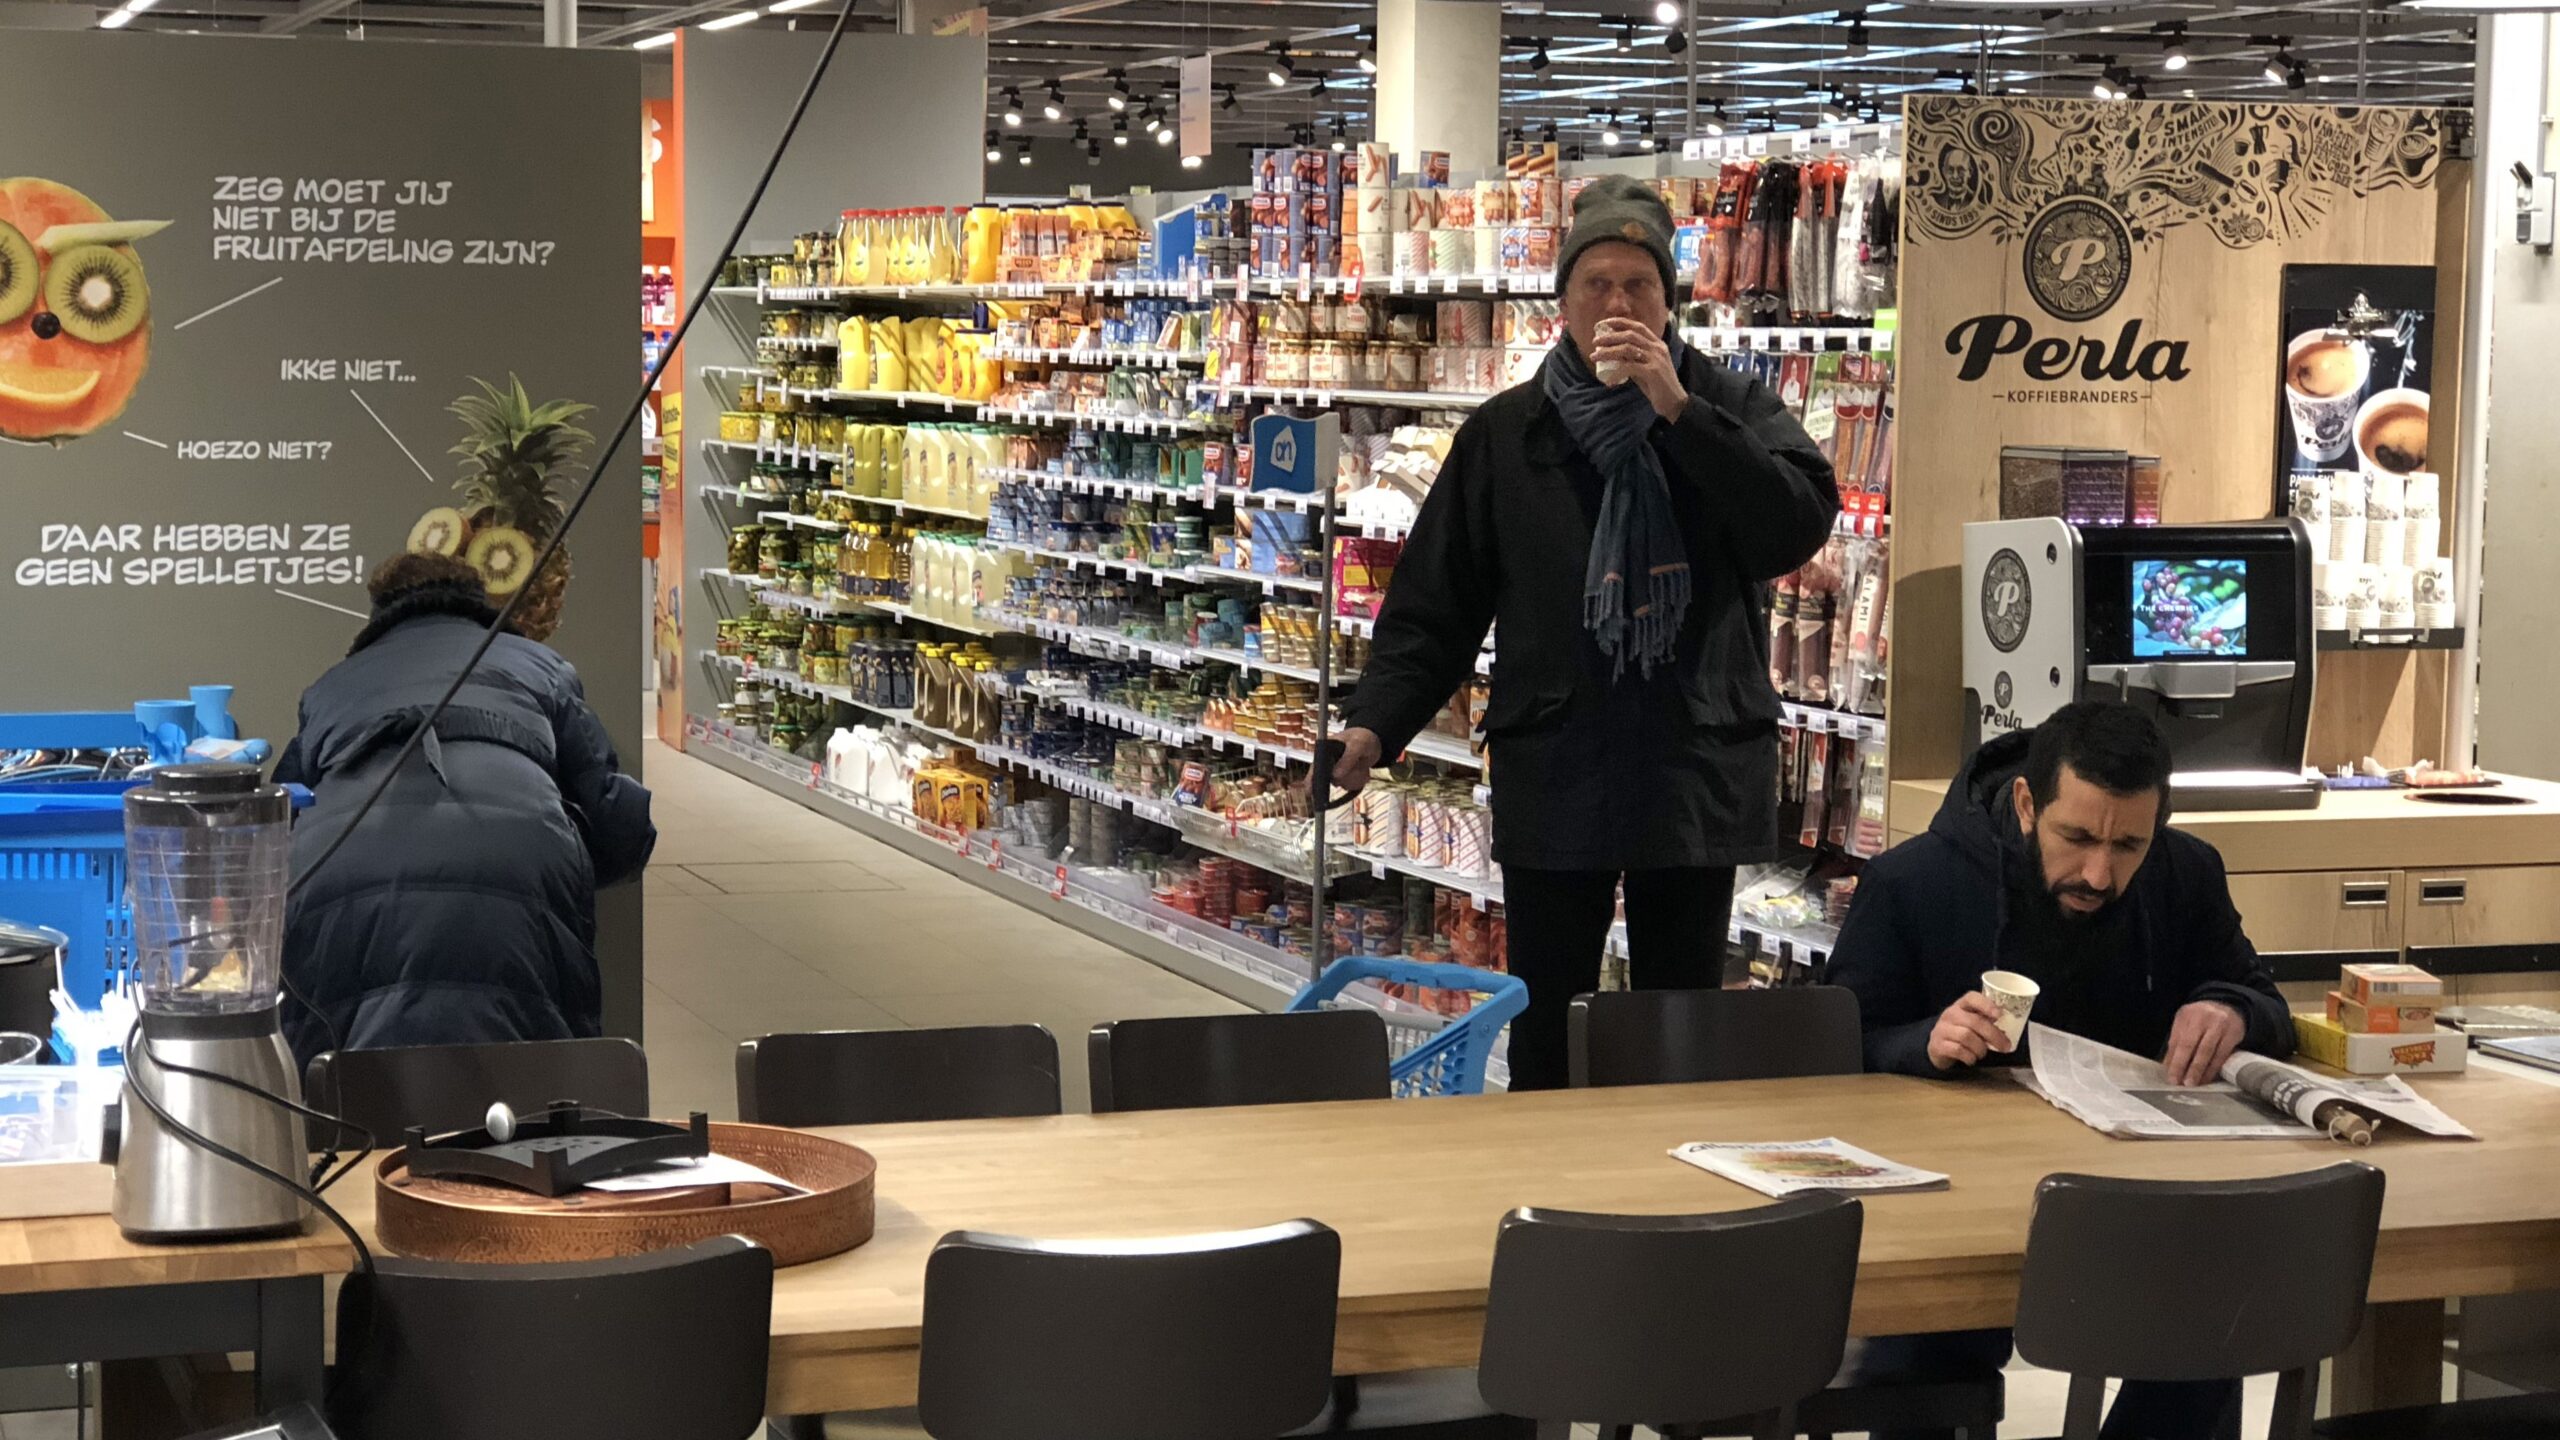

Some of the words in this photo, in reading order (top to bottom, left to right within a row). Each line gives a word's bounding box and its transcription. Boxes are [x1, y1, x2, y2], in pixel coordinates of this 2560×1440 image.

[213, 176, 284, 202] ZEG
[294, 178, 386, 204] MOET
[395, 181, 453, 206] JIJ
[213, 205, 281, 232] NIET
[290, 207, 344, 233] BIJ
[354, 208, 396, 234] DE
[213, 235, 454, 264] FRUITAFDELING
[463, 240, 556, 266] ZIJN?
[2051, 239, 2106, 281] P
[1945, 314, 2191, 381] Perla
[280, 358, 337, 382] IKKE
[344, 358, 417, 383] NIET...
[2007, 390, 2140, 404] KOFFIEBRANDERS
[177, 440, 261, 460] HOEZO
[268, 440, 333, 460] NIET?
[40, 523, 143, 553] DAAR
[153, 523, 290, 553] HEBBEN
[300, 524, 351, 552] ZE
[15, 557, 113, 586] GEEN
[122, 557, 364, 587] SPELLETJES!
[1981, 704, 2023, 730] Perla
